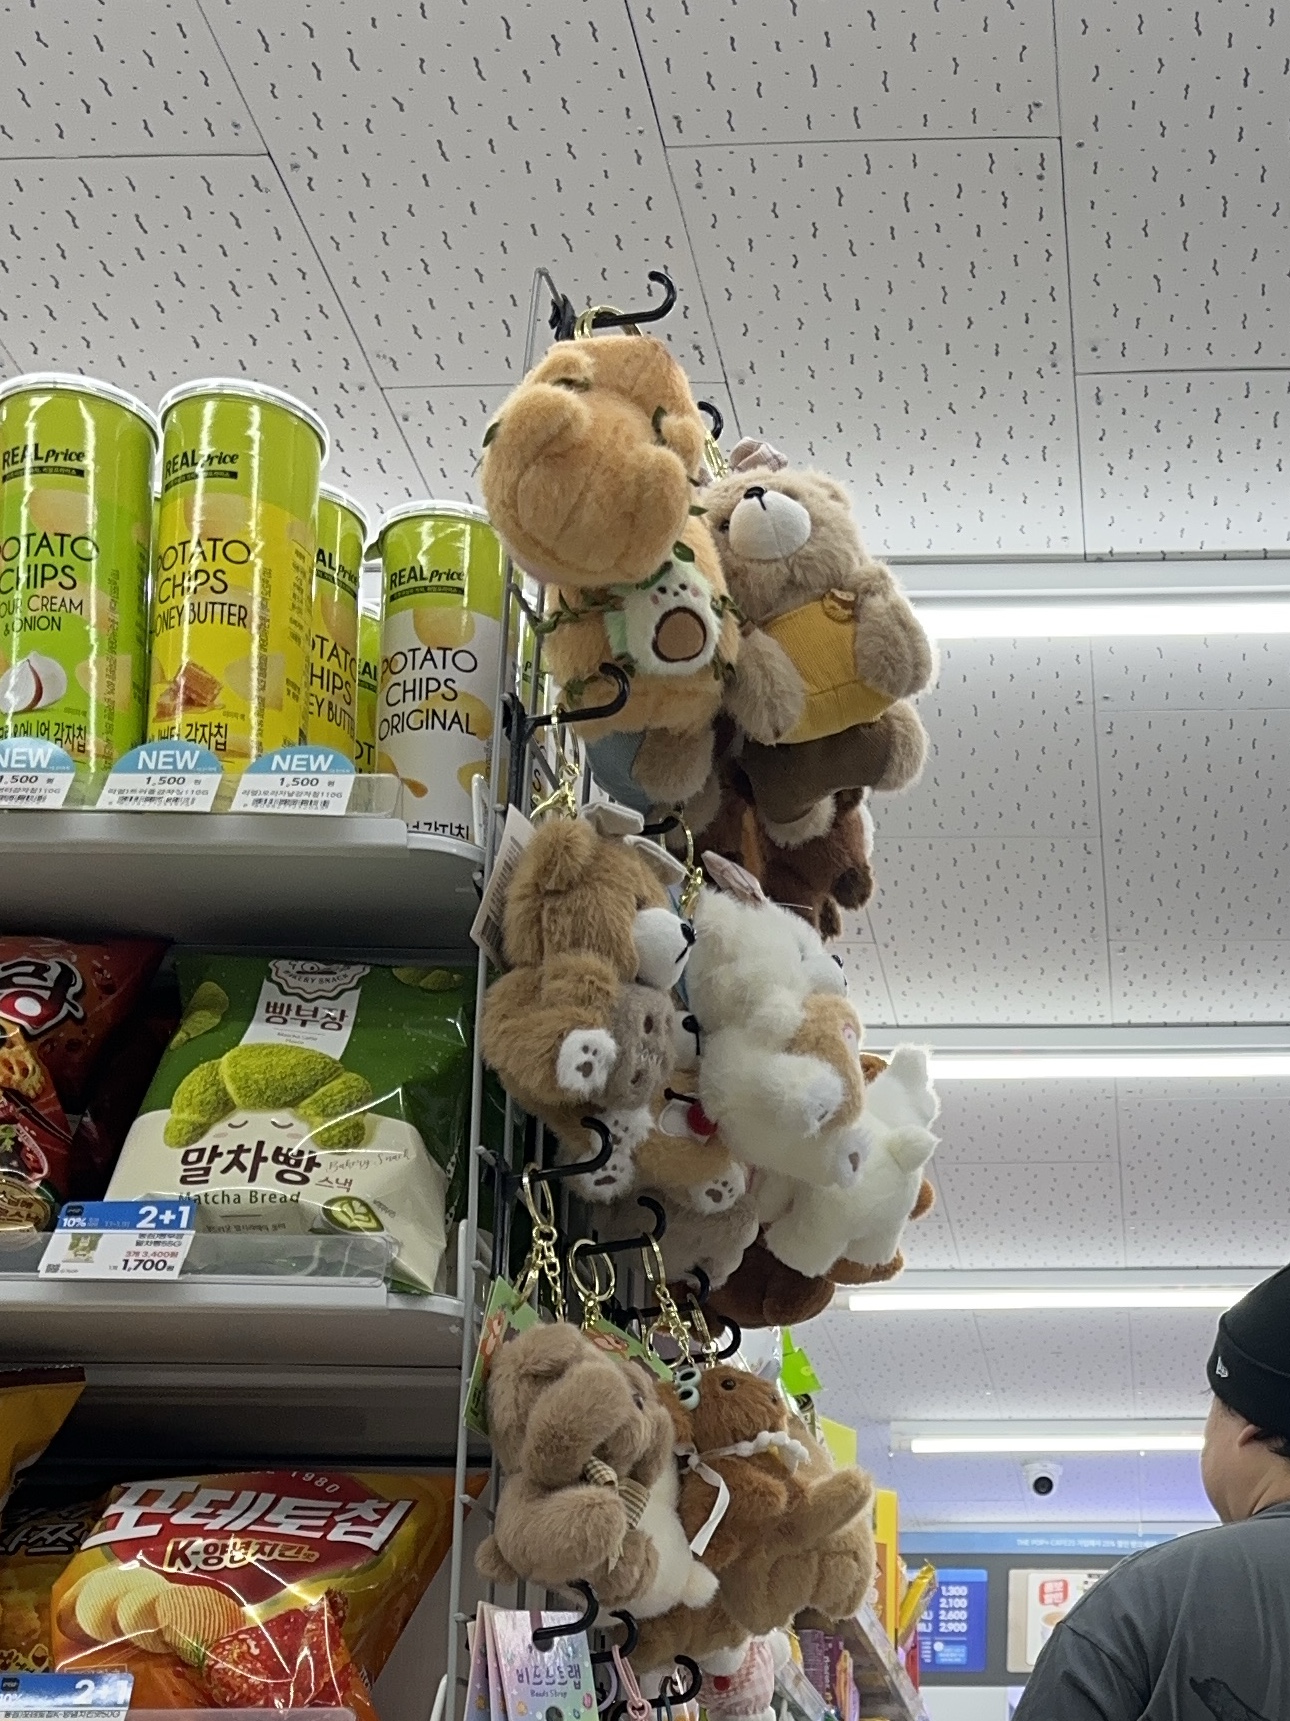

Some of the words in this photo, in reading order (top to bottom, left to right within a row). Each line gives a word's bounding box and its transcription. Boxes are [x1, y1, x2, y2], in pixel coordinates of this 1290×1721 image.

[0, 531, 99, 563] OTATO
[0, 564, 77, 595] CHIPS
[158, 569, 228, 605] CHIPS
[27, 595, 84, 615] CREAM
[189, 601, 248, 629] BUTTER
[12, 615, 62, 633] ONION
[381, 647, 478, 683] POTATO
[386, 678, 458, 707] CHIPS
[54, 722, 86, 753] 감자칩
[185, 722, 228, 752] 감자칩
[378, 709, 477, 742] ORIGINAL
[0, 748, 53, 770] NEW
[138, 750, 199, 770] NEW
[271, 754, 334, 772] NEW
[265, 1001, 348, 1031] 빵부장
[179, 1140, 323, 1187] 말차빵
[179, 1191, 242, 1206] Matcha
[249, 1190, 301, 1205] Bread
[314, 1176, 353, 1193] 스낵
[62, 1218, 87, 1229] 10%
[136, 1206, 191, 1230] 2+1
[81, 1481, 414, 1552] 포테토칩
[73, 1679, 129, 1705] 2+1
